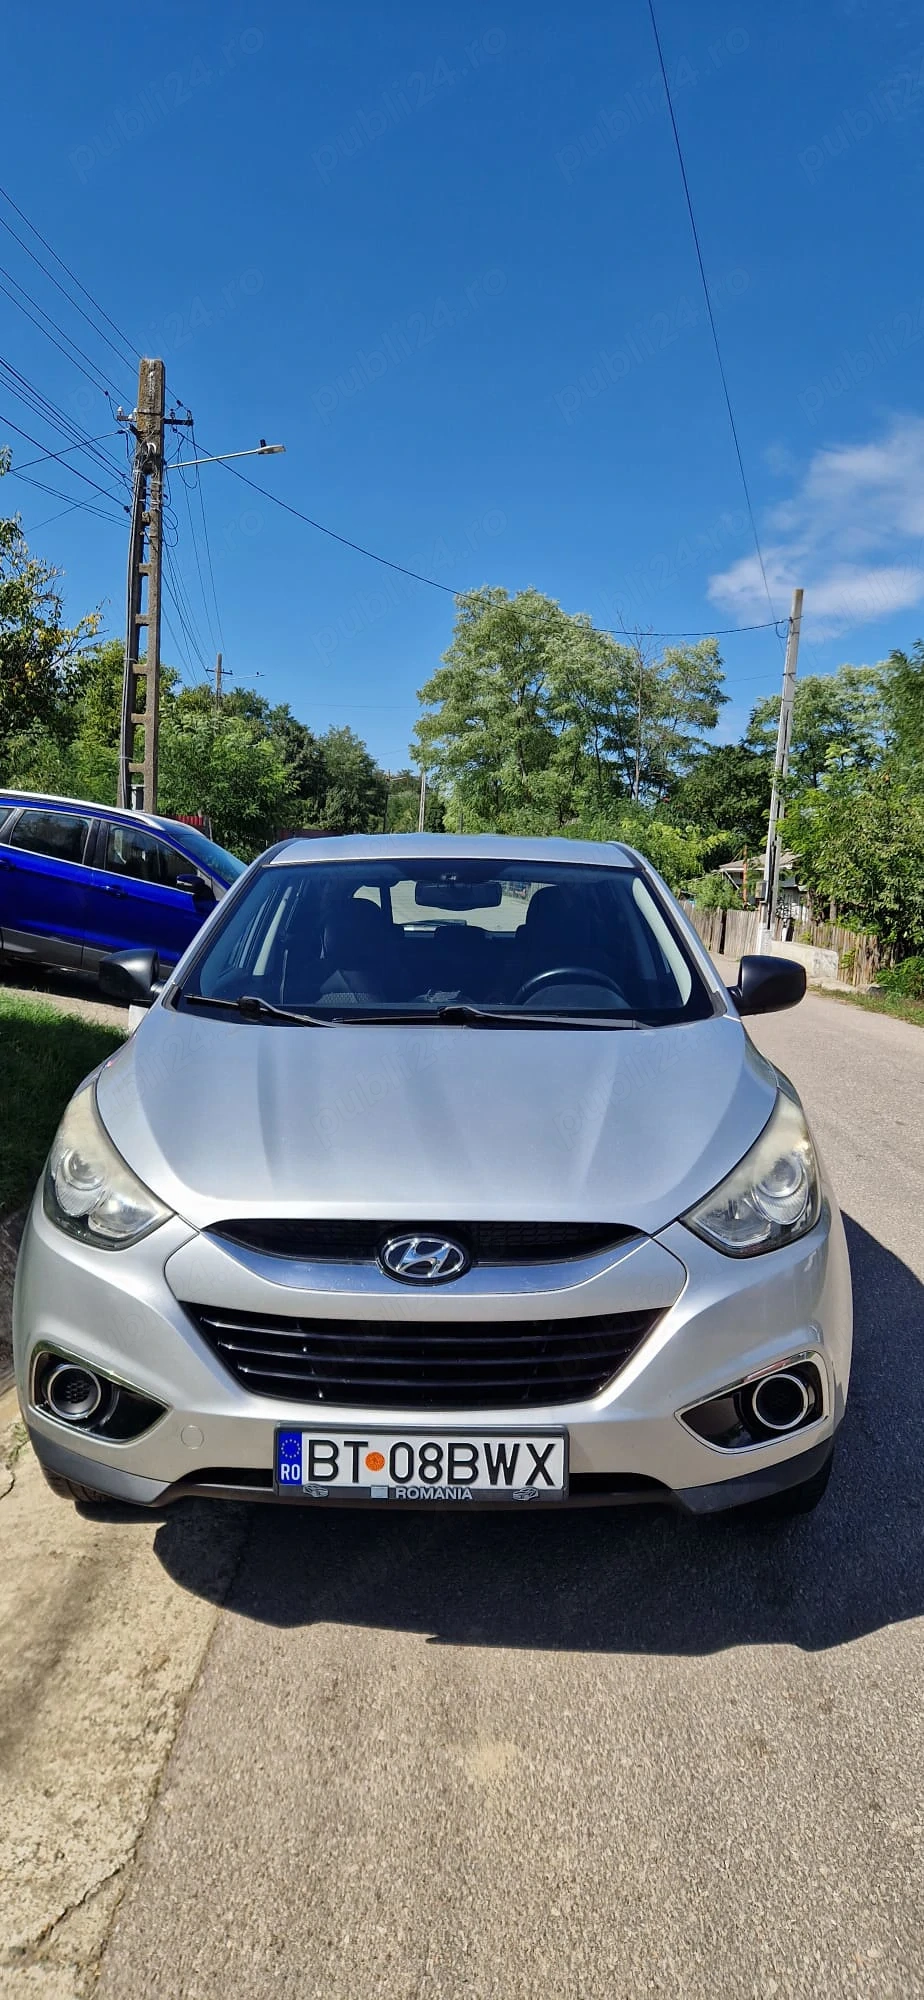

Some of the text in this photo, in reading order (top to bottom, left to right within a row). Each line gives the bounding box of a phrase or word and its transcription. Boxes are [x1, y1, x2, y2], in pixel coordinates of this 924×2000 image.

[308, 1439, 556, 1486] BT 08BWX
[280, 1463, 301, 1481] RO
[395, 1487, 473, 1500] ROMANIA
